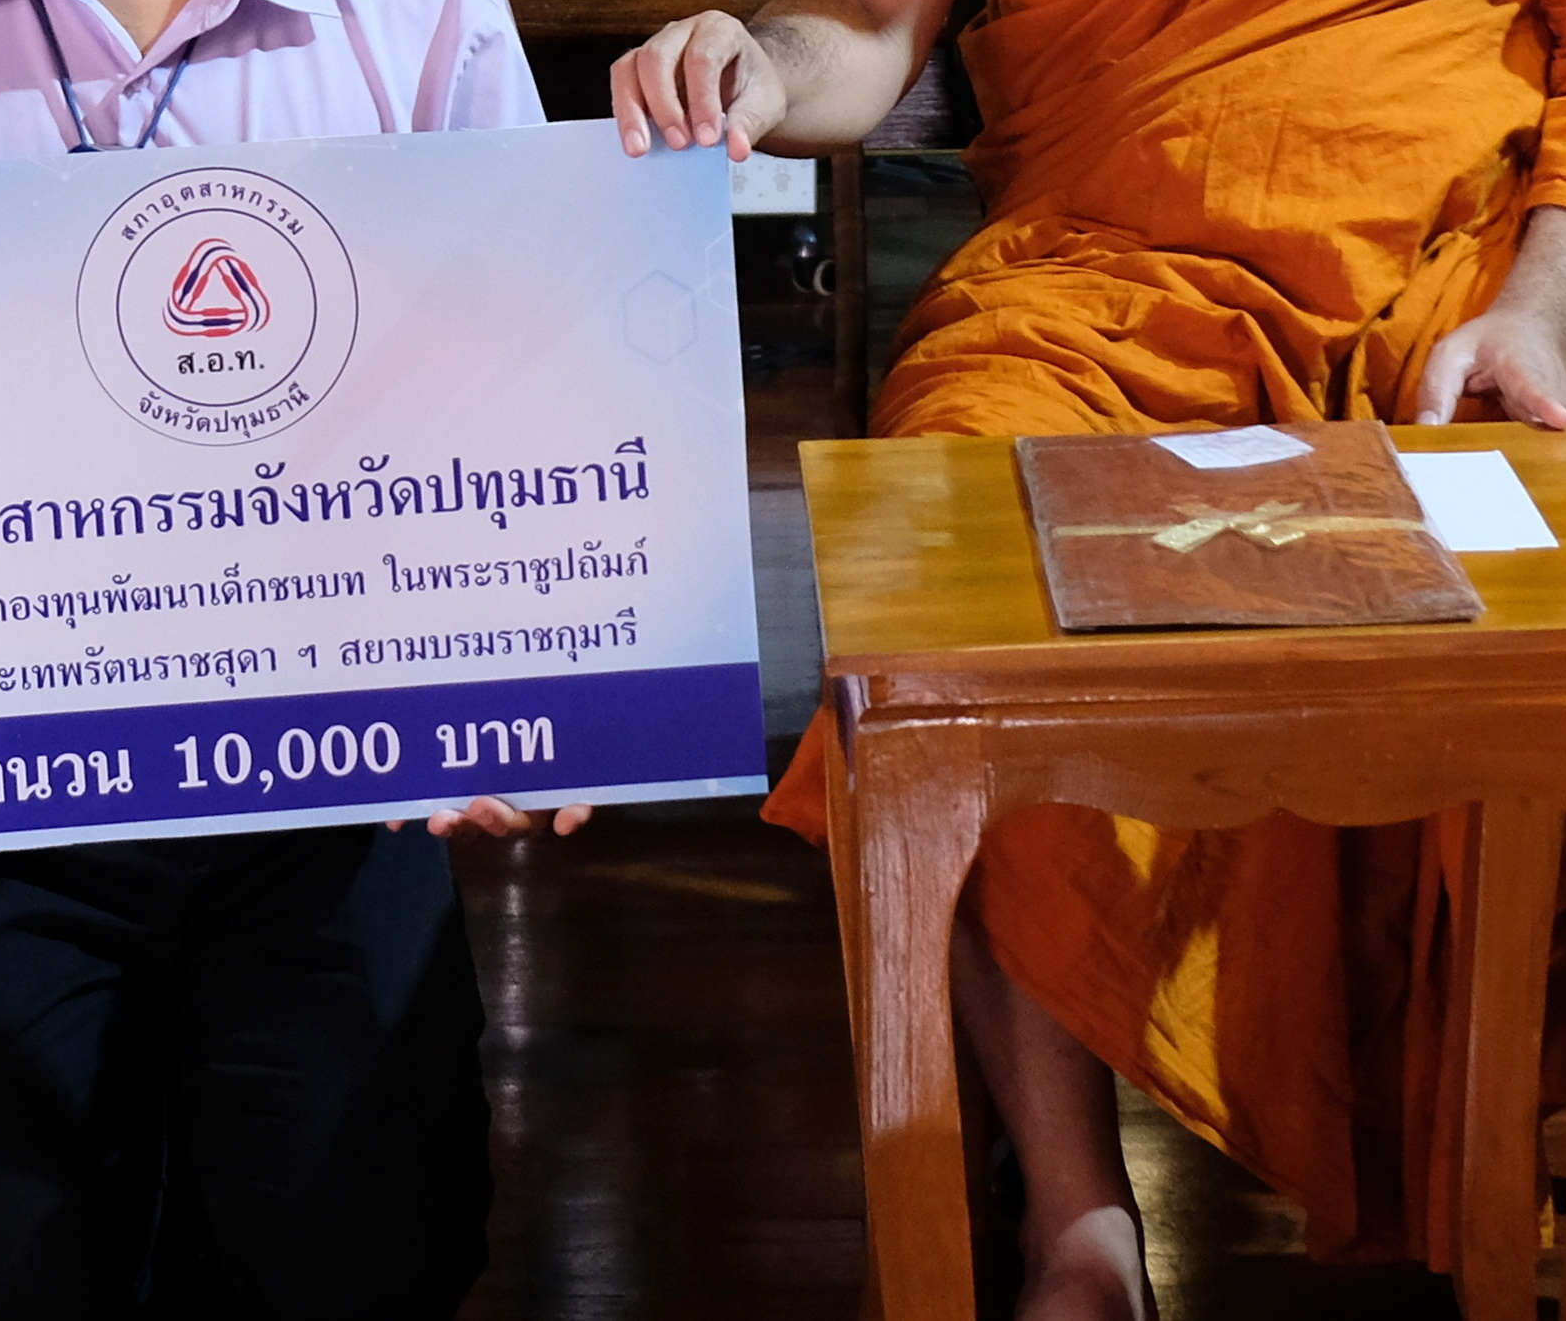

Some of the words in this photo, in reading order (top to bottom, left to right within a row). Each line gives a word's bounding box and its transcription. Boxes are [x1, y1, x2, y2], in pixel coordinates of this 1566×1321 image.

[120, 180, 305, 242] สภาอุตสาหกรรม
[176, 349, 266, 375] ส.อ.ท.
[138, 380, 311, 439] จังหวัดปทุมธานี
[382, 536, 649, 595] ในพระราชูปถัมภ์
[339, 606, 639, 668] สยามบรมราชกุมารี
[173, 721, 401, 794] 10,000
[435, 715, 556, 769] บาท
